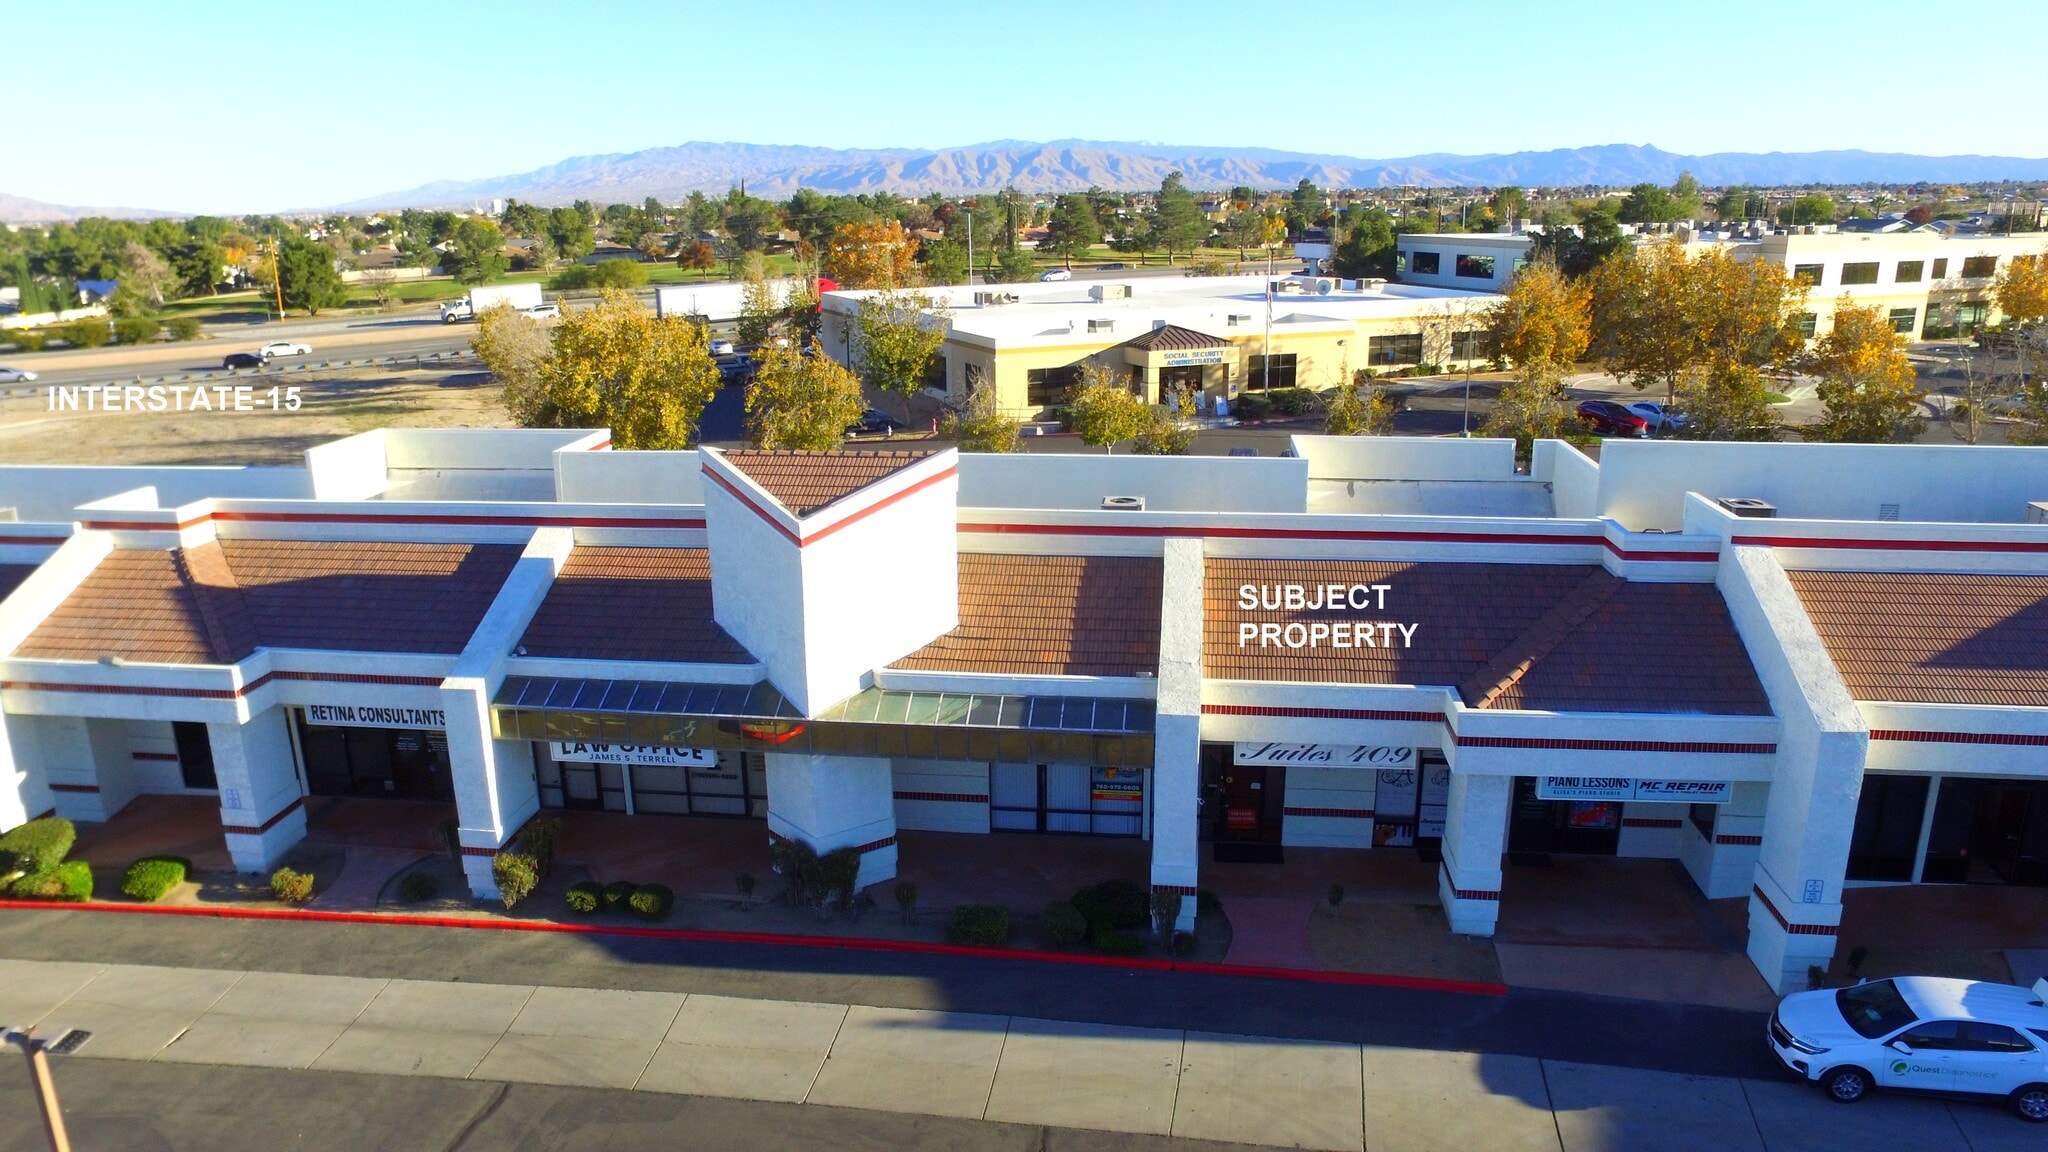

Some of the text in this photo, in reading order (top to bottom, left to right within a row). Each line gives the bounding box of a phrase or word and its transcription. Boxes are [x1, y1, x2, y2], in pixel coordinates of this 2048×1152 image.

[311, 704, 446, 726] RETINA CONSULTANTS
[561, 742, 610, 755] LAW
[1239, 742, 1413, 764] Suites 409
[637, 755, 676, 763] TERRELL
[1548, 776, 1630, 789] PIANO LESSONS
[1640, 781, 1726, 792] MC REPAIR
[1912, 1064, 1940, 1074] Quest
